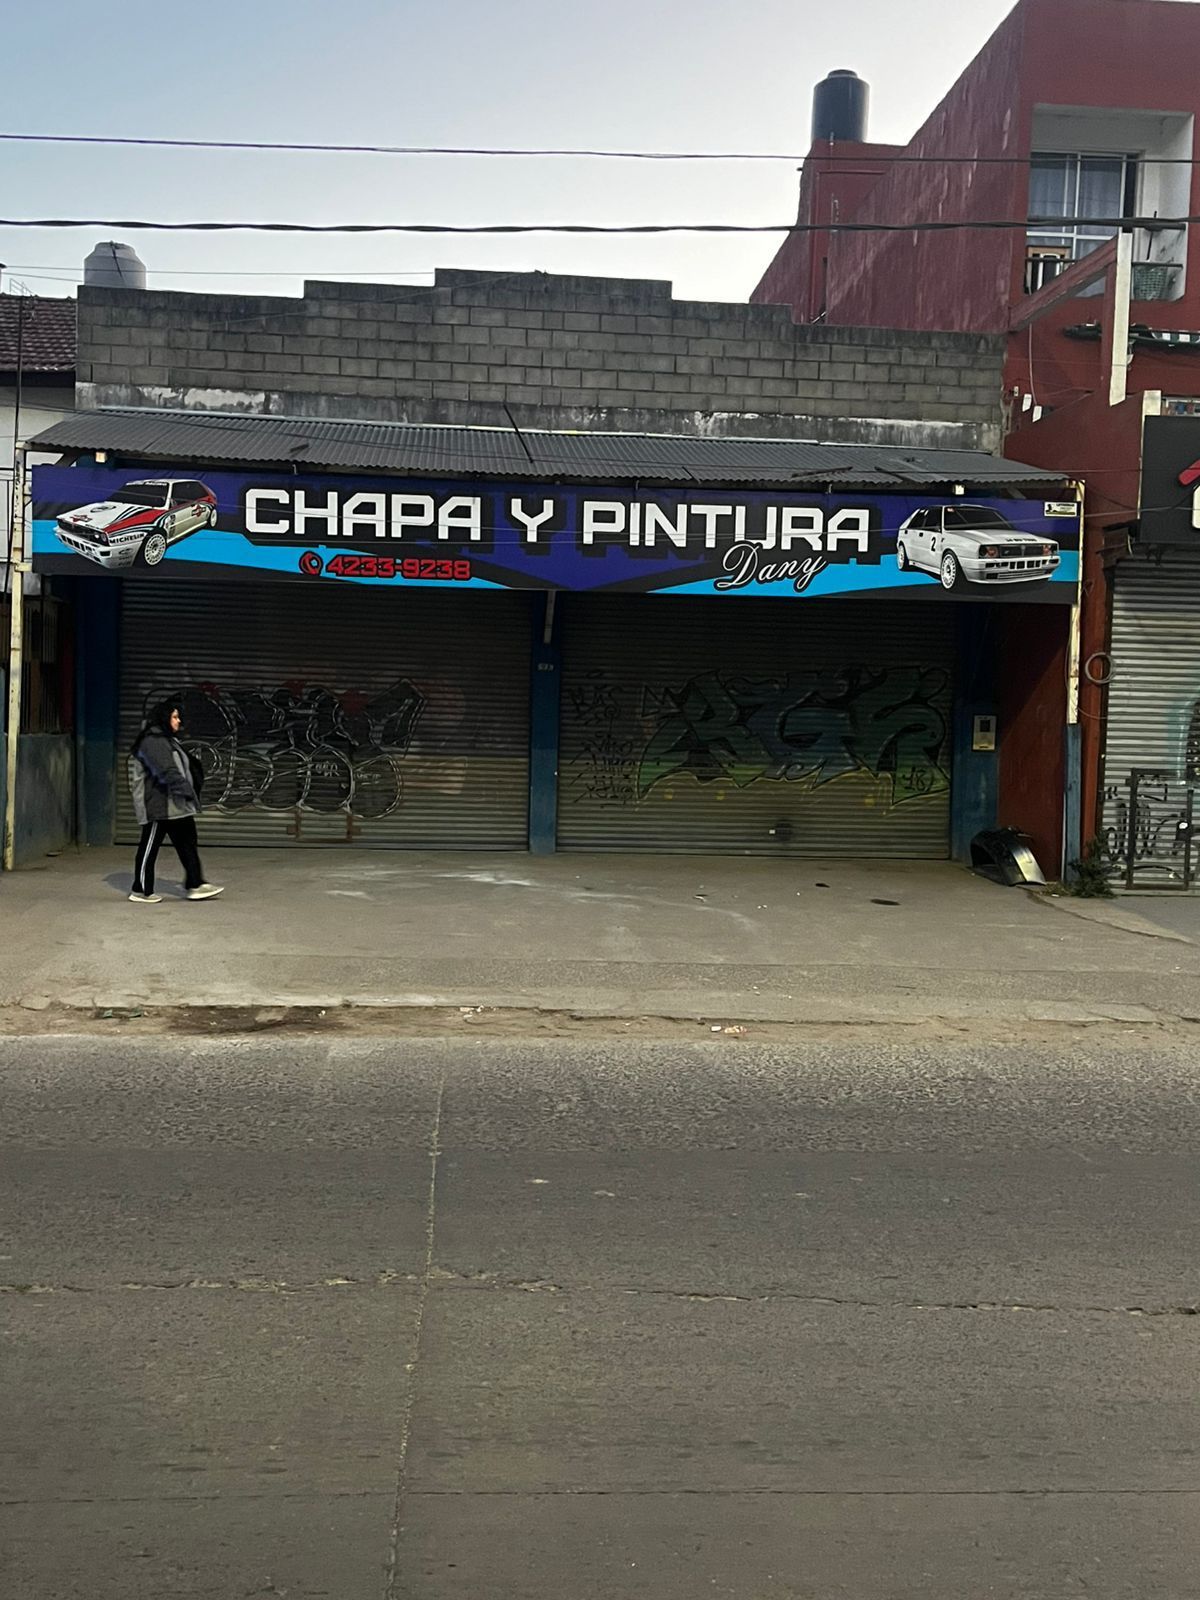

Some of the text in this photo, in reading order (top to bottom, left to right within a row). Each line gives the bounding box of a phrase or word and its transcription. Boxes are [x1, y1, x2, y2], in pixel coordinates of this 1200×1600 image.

[245, 488, 870, 554] CHAPA Y PINTURA
[109, 532, 145, 544] MICHELIN
[930, 535, 937, 552] 2
[328, 556, 471, 580] 4233-9238
[714, 543, 827, 590] Dany
